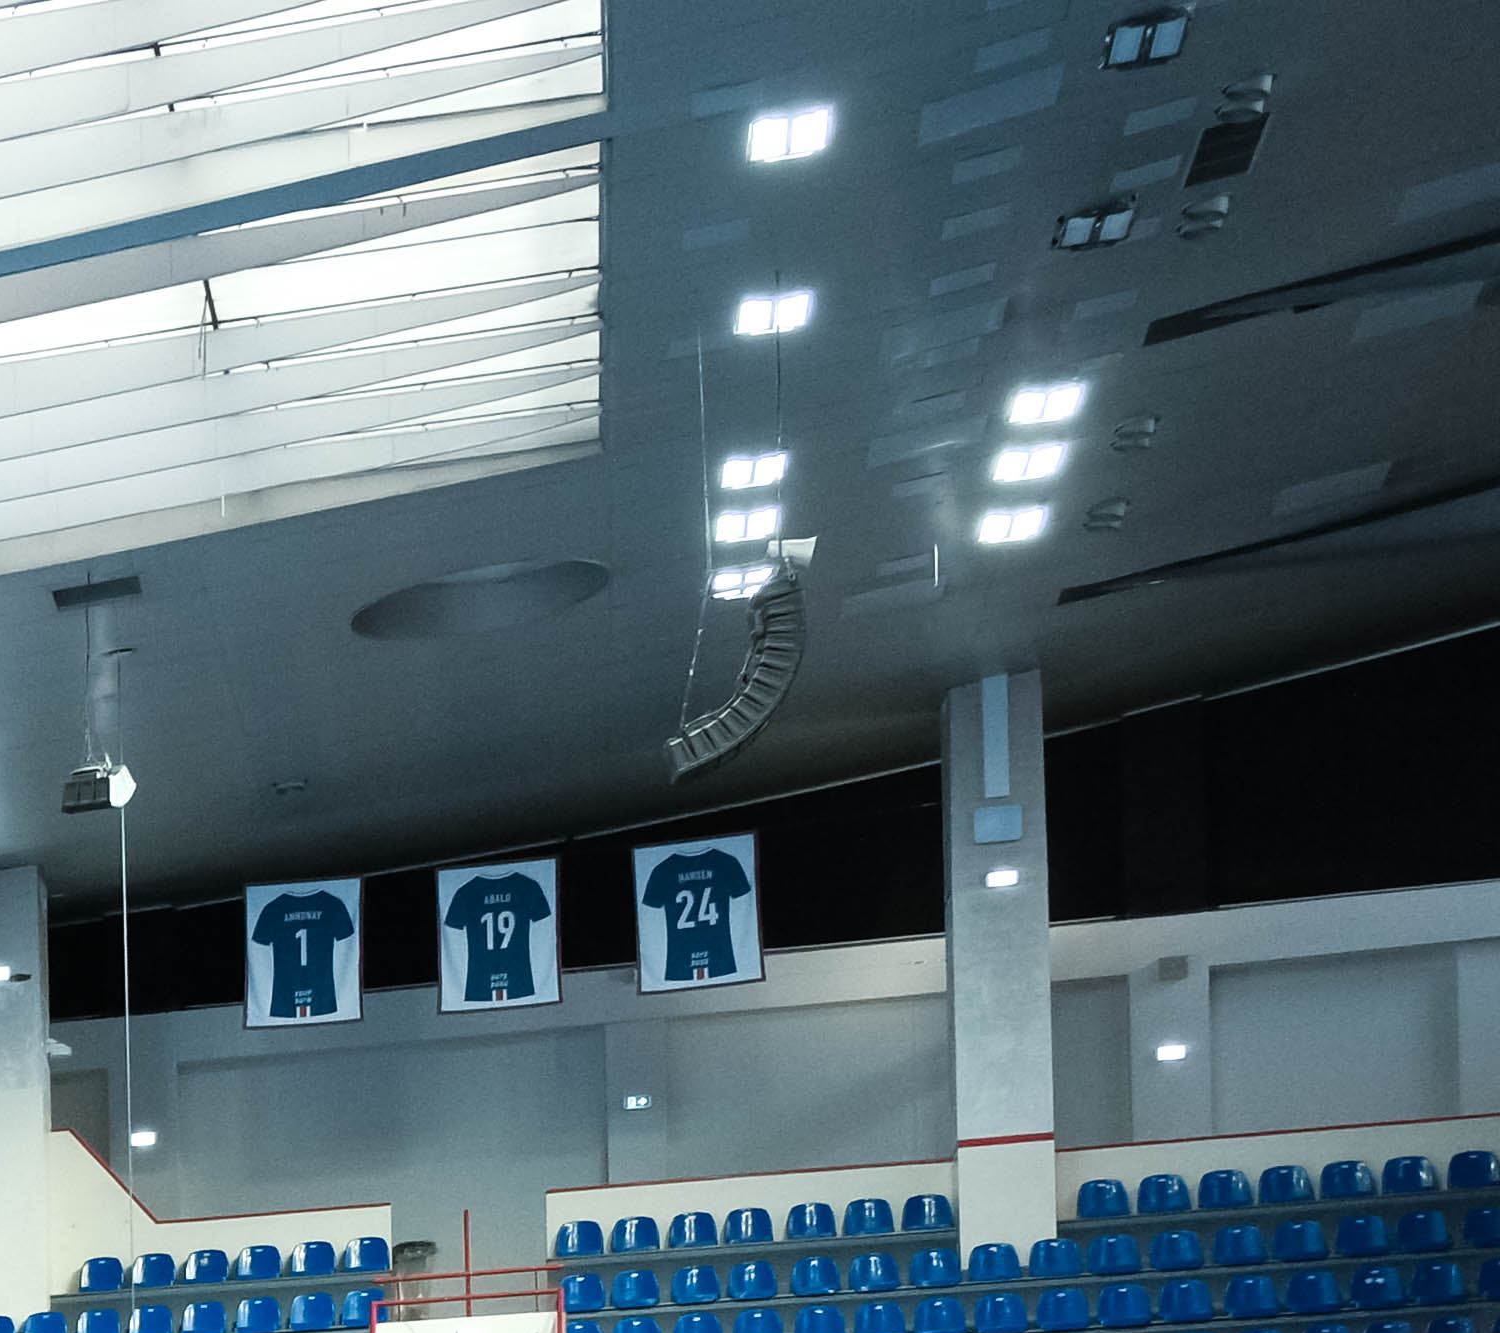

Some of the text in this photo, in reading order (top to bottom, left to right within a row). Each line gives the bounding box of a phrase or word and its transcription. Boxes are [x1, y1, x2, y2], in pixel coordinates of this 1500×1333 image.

[675, 887, 719, 930] 24
[295, 928, 308, 967] 1
[480, 911, 516, 950] 19
